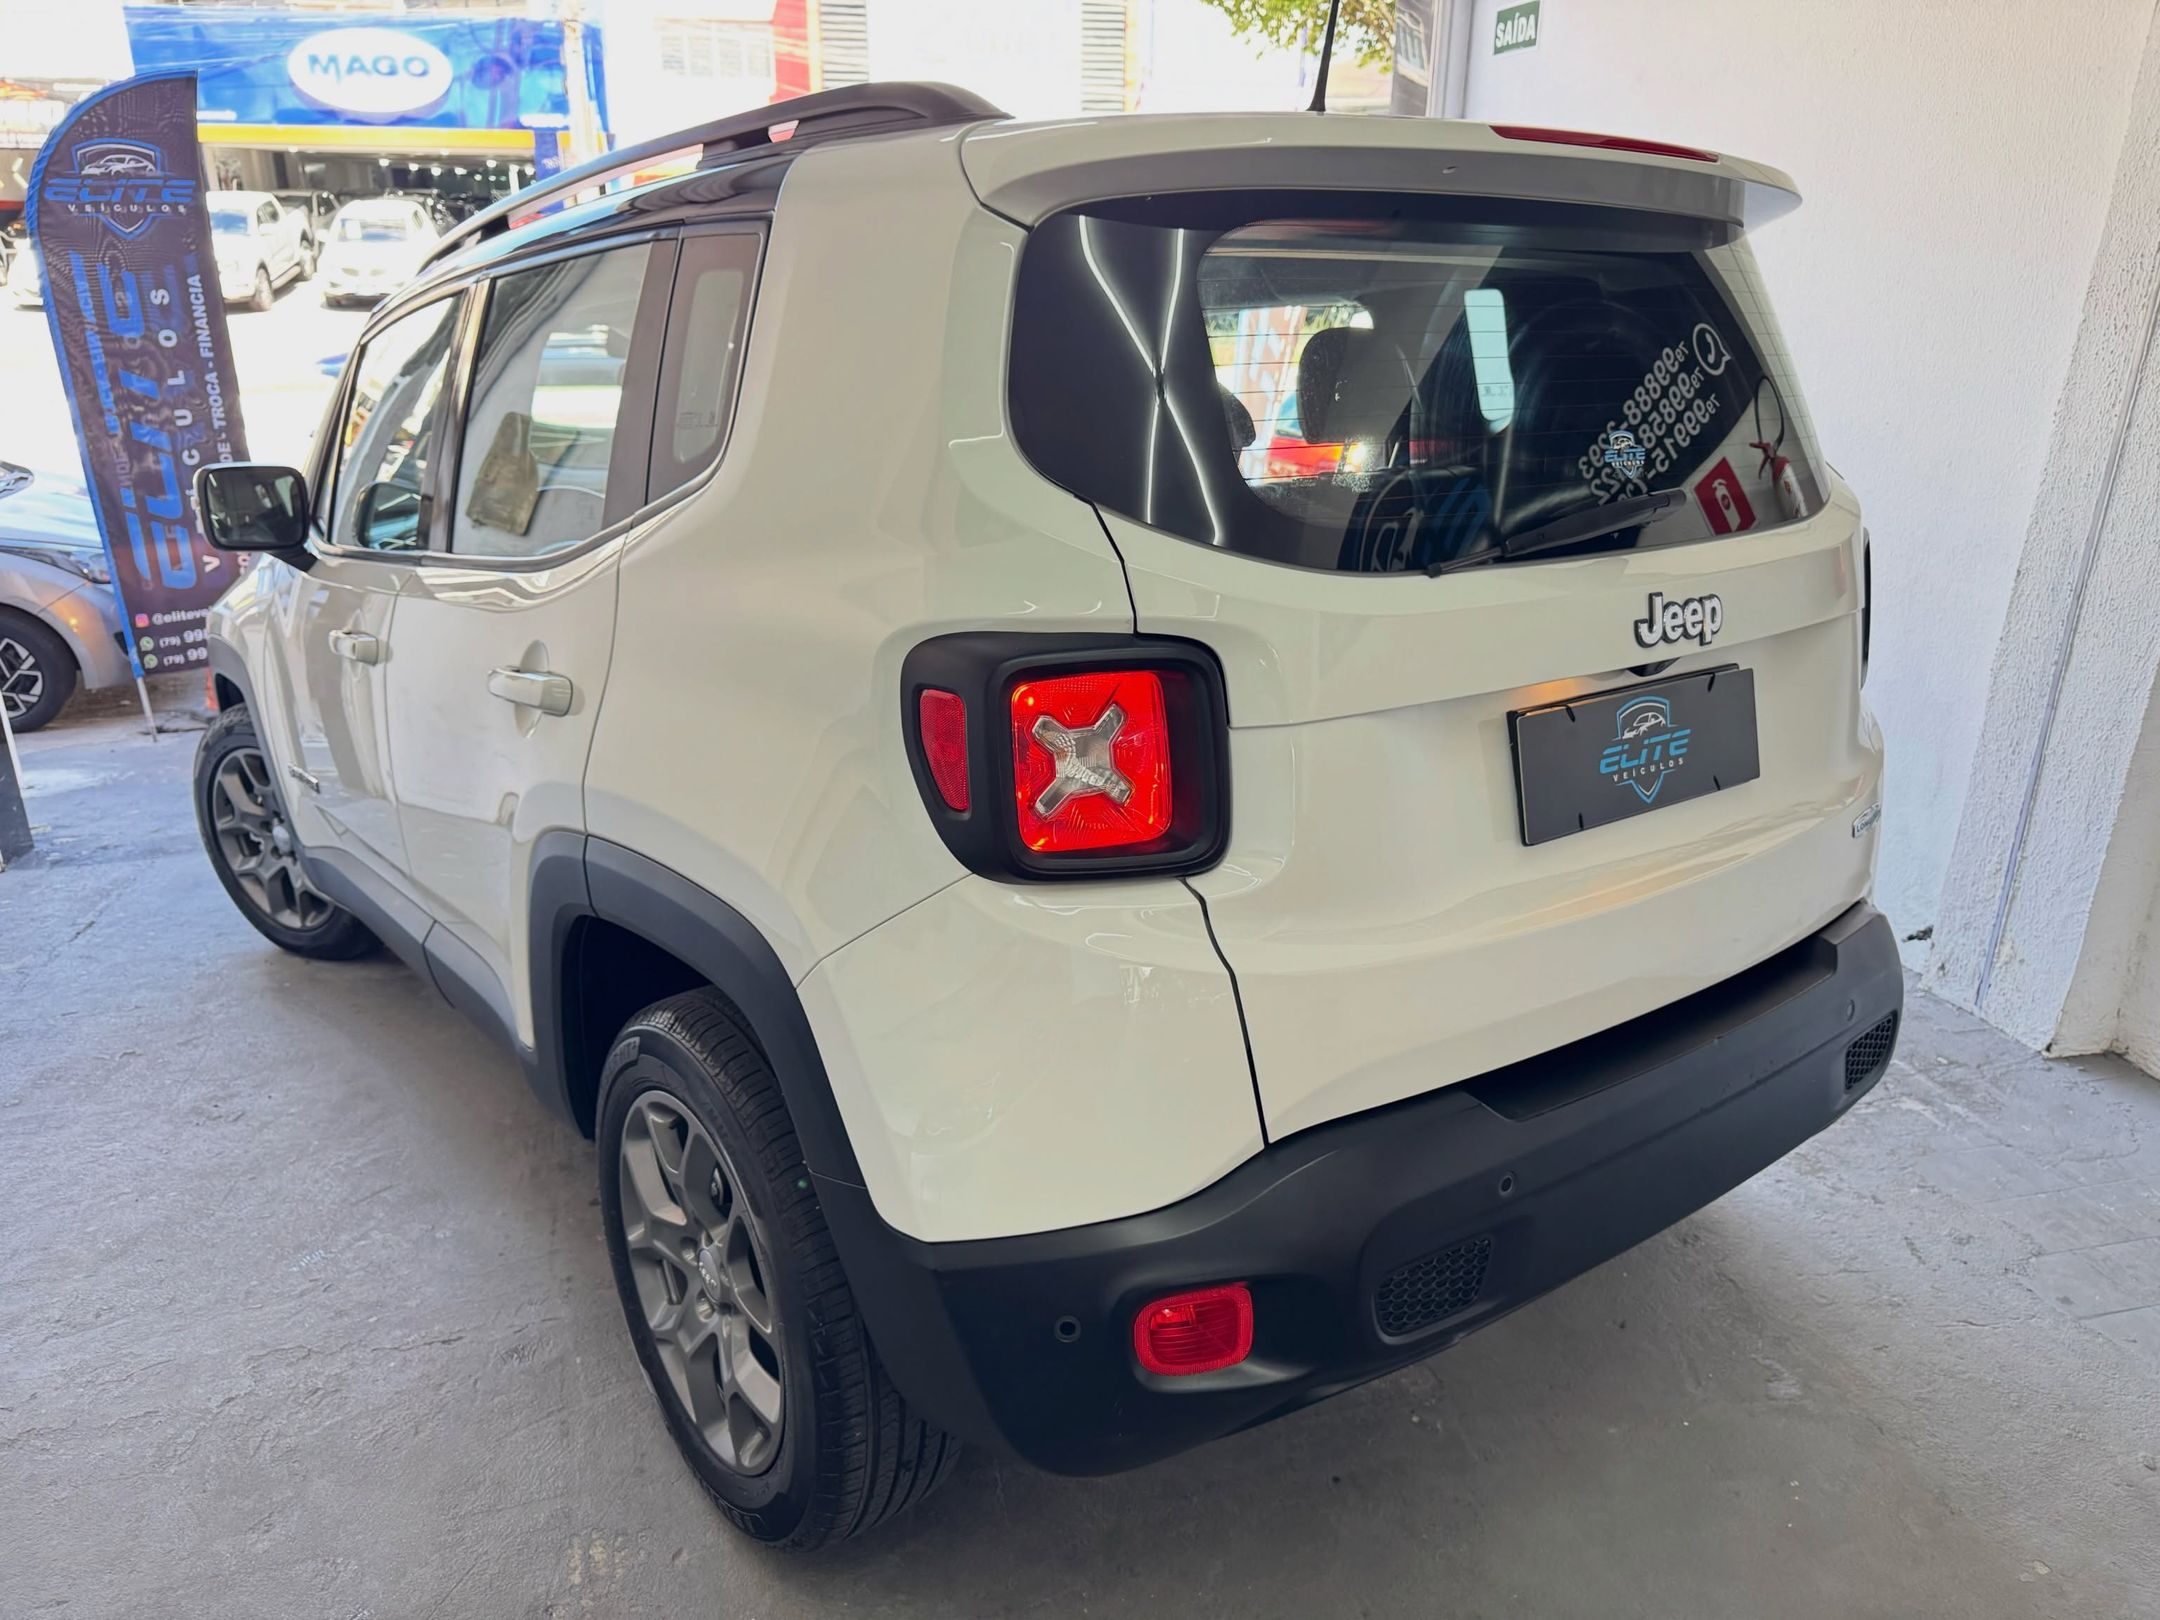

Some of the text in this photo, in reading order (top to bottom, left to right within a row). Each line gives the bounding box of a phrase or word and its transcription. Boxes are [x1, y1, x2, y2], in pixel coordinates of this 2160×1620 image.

[1495, 11, 1536, 48] SAÍDA
[44, 178, 196, 203] ELITE
[186, 273, 214, 359] FINANCIA
[70, 250, 197, 589] ELITE
[208, 371, 228, 430] TROCA
[150, 288, 221, 573] VCULOS
[1634, 592, 1723, 648] Jeep
[1599, 728, 1691, 774] ELITE
